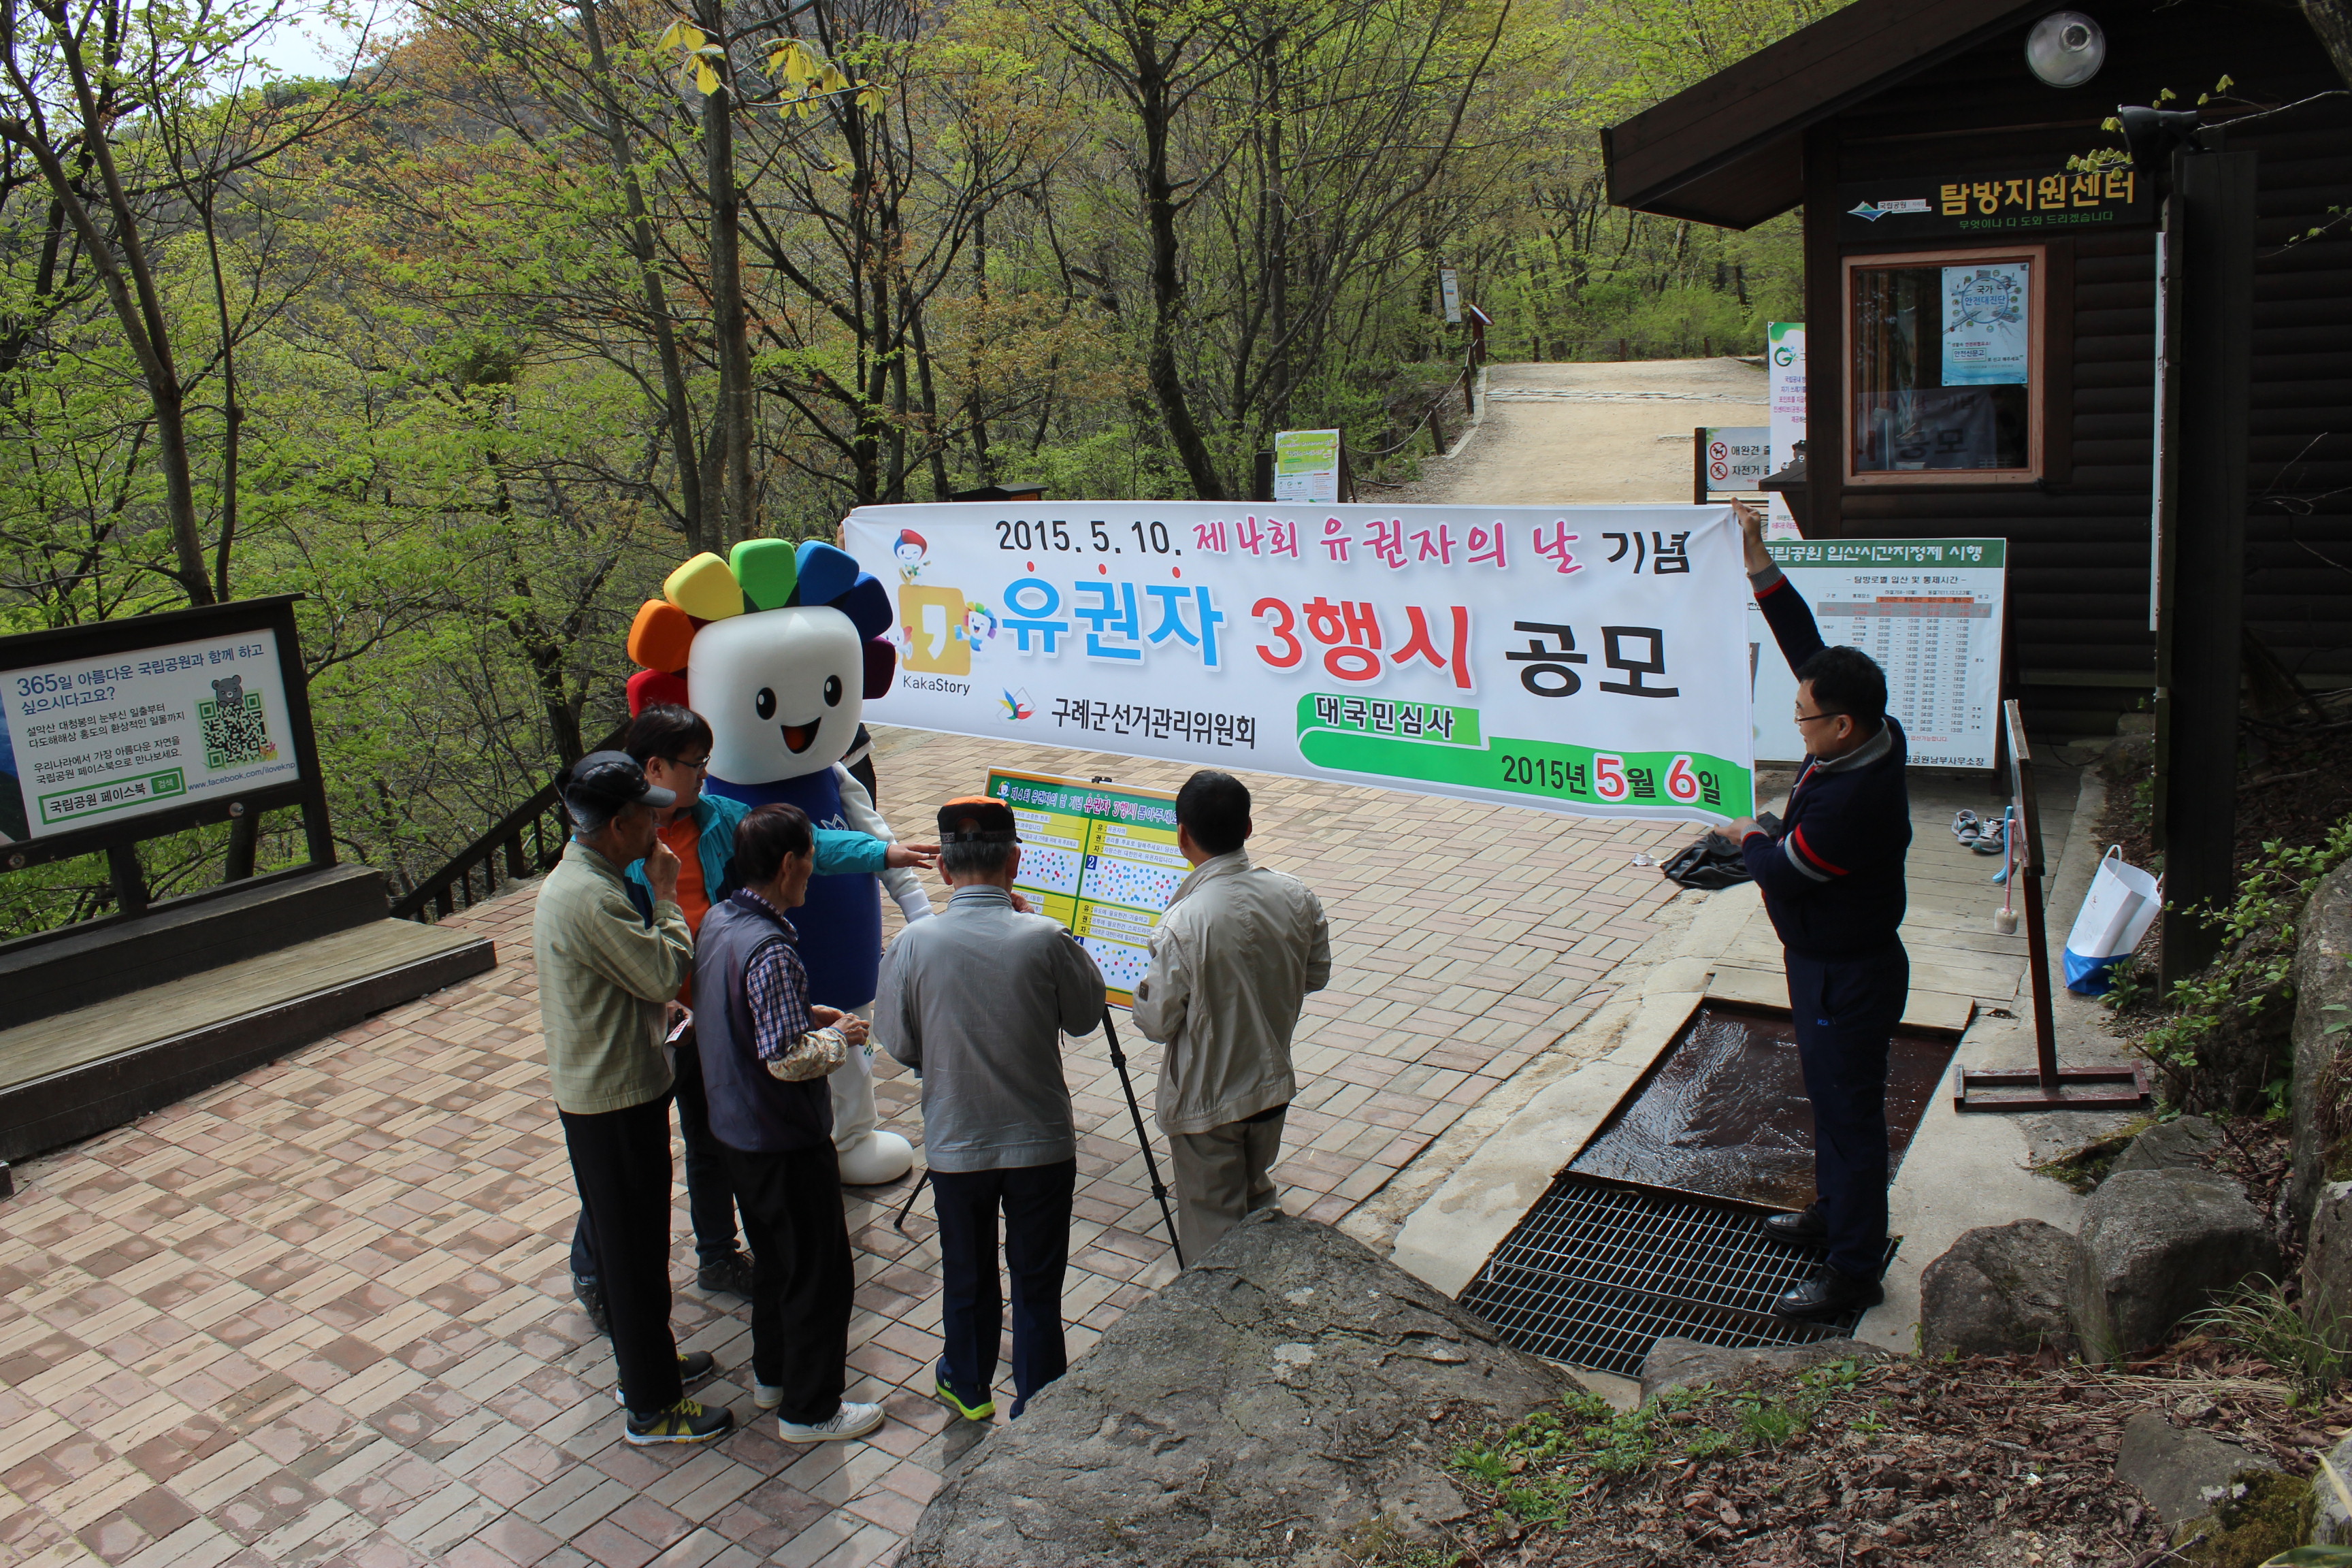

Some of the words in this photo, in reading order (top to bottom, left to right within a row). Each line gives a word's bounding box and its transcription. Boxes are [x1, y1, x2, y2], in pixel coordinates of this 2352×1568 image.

[1941, 172, 2134, 215] 탐방지원센터
[1959, 218, 2002, 229] 무엇이나
[2006, 217, 2016, 227] 다
[2021, 216, 2042, 226] 도와
[2047, 211, 2114, 225] 드리겠습니다
[1965, 295, 2006, 306] 안전대진단
[1977, 284, 1993, 294] 국가
[1731, 446, 1759, 455] 애완견
[1732, 466, 1759, 475] 자전거
[996, 521, 1081, 553] 2015.
[1131, 521, 1182, 557] 10.
[1321, 517, 1507, 570] 유권자의
[1534, 521, 1583, 574] 날
[1602, 531, 1691, 574] 기념
[1827, 545, 1942, 562] 입산시간지정제
[1949, 545, 1983, 561] 시행
[1854, 576, 1888, 584] 탐방로별
[1891, 576, 1908, 584] 입산
[1912, 576, 1919, 584] 및
[1923, 576, 1958, 584] 통제시간
[1002, 577, 1224, 667] 유권자
[1252, 595, 1471, 689] 3행시
[1506, 621, 1679, 698] 공모
[17, 674, 73, 697] 365일
[78, 665, 133, 686] 아름다운
[138, 653, 204, 676] 국립공원과
[208, 649, 235, 666] 함께
[238, 643, 264, 659] 하고
[21, 687, 116, 715] 싶으시다고요?
[903, 675, 970, 697] KakaStory
[27, 722, 56, 737] 설악산
[59, 715, 97, 730] 대청봉의
[99, 710, 127, 723] 눈부신
[130, 703, 165, 718] 일출부터
[29, 731, 77, 749] 다도해해상
[80, 725, 108, 740] 홍도의
[111, 719, 147, 734] 환상적인
[150, 711, 186, 725] 일몰까지
[1051, 698, 1256, 749] 구례군선거관리위원회
[1316, 696, 1454, 739] 대국민심사
[34, 754, 91, 772] 우리나라에서
[94, 749, 112, 760] 가장
[116, 741, 151, 756] 아름다운
[154, 735, 180, 748] 자연을
[36, 769, 75, 784] 국립공원
[78, 758, 133, 777] 페이스북으로
[135, 747, 182, 764] 만나보세요.
[188, 761, 295, 791] www.facebook.com/iloveknp
[1502, 755, 1586, 795] 2015년
[1596, 757, 1656, 798] 5월
[1667, 758, 1721, 806] 6일
[50, 793, 97, 814] 국립공원
[101, 781, 146, 803] 페이스북
[158, 779, 174, 789] 검색
[1011, 787, 1030, 802] 제4회
[1032, 789, 1058, 806] 유권자의
[1060, 794, 1067, 808] 날
[1069, 796, 1083, 811] 기념
[1084, 797, 1111, 816] 유권자
[1113, 801, 1138, 820] 3행시
[1107, 826, 1126, 834] 유권자의
[1088, 856, 1095, 868] 2
[1124, 849, 1143, 858] 대한민국
